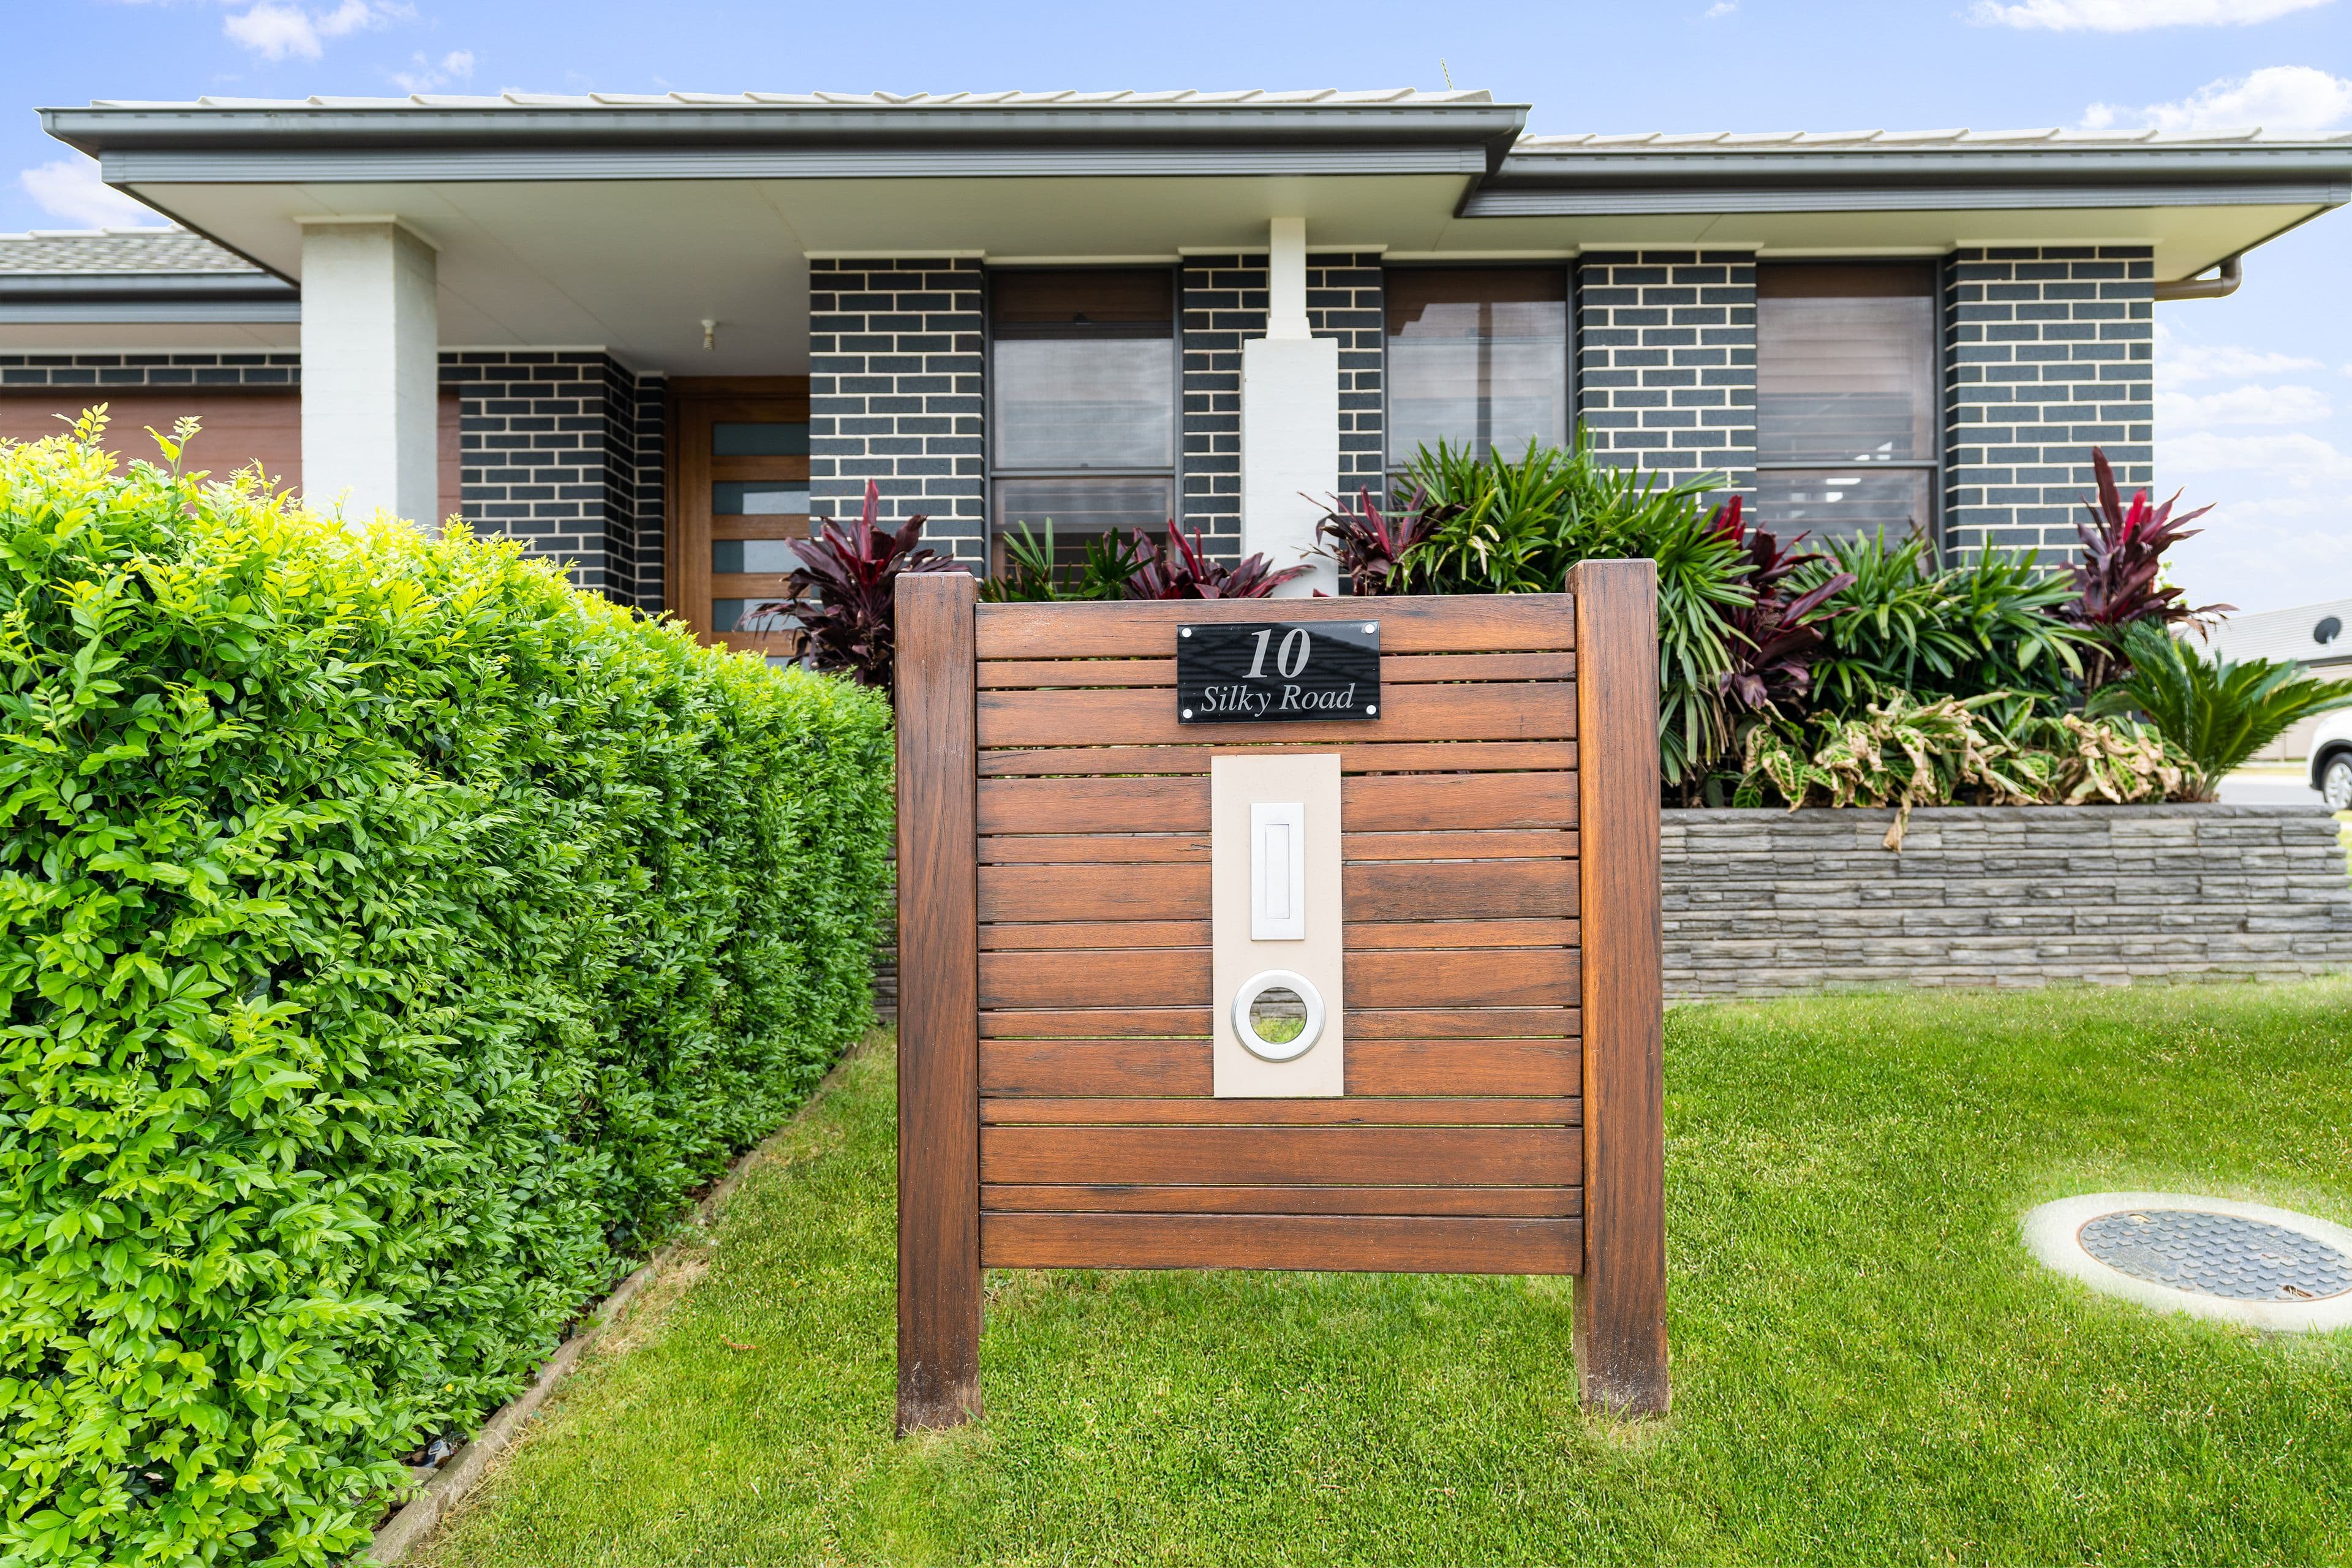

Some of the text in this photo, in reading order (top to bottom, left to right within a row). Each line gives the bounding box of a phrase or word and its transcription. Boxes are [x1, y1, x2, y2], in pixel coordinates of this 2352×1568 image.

[1242, 628, 1311, 679] 10
[1200, 682, 1356, 717] Silky Road
